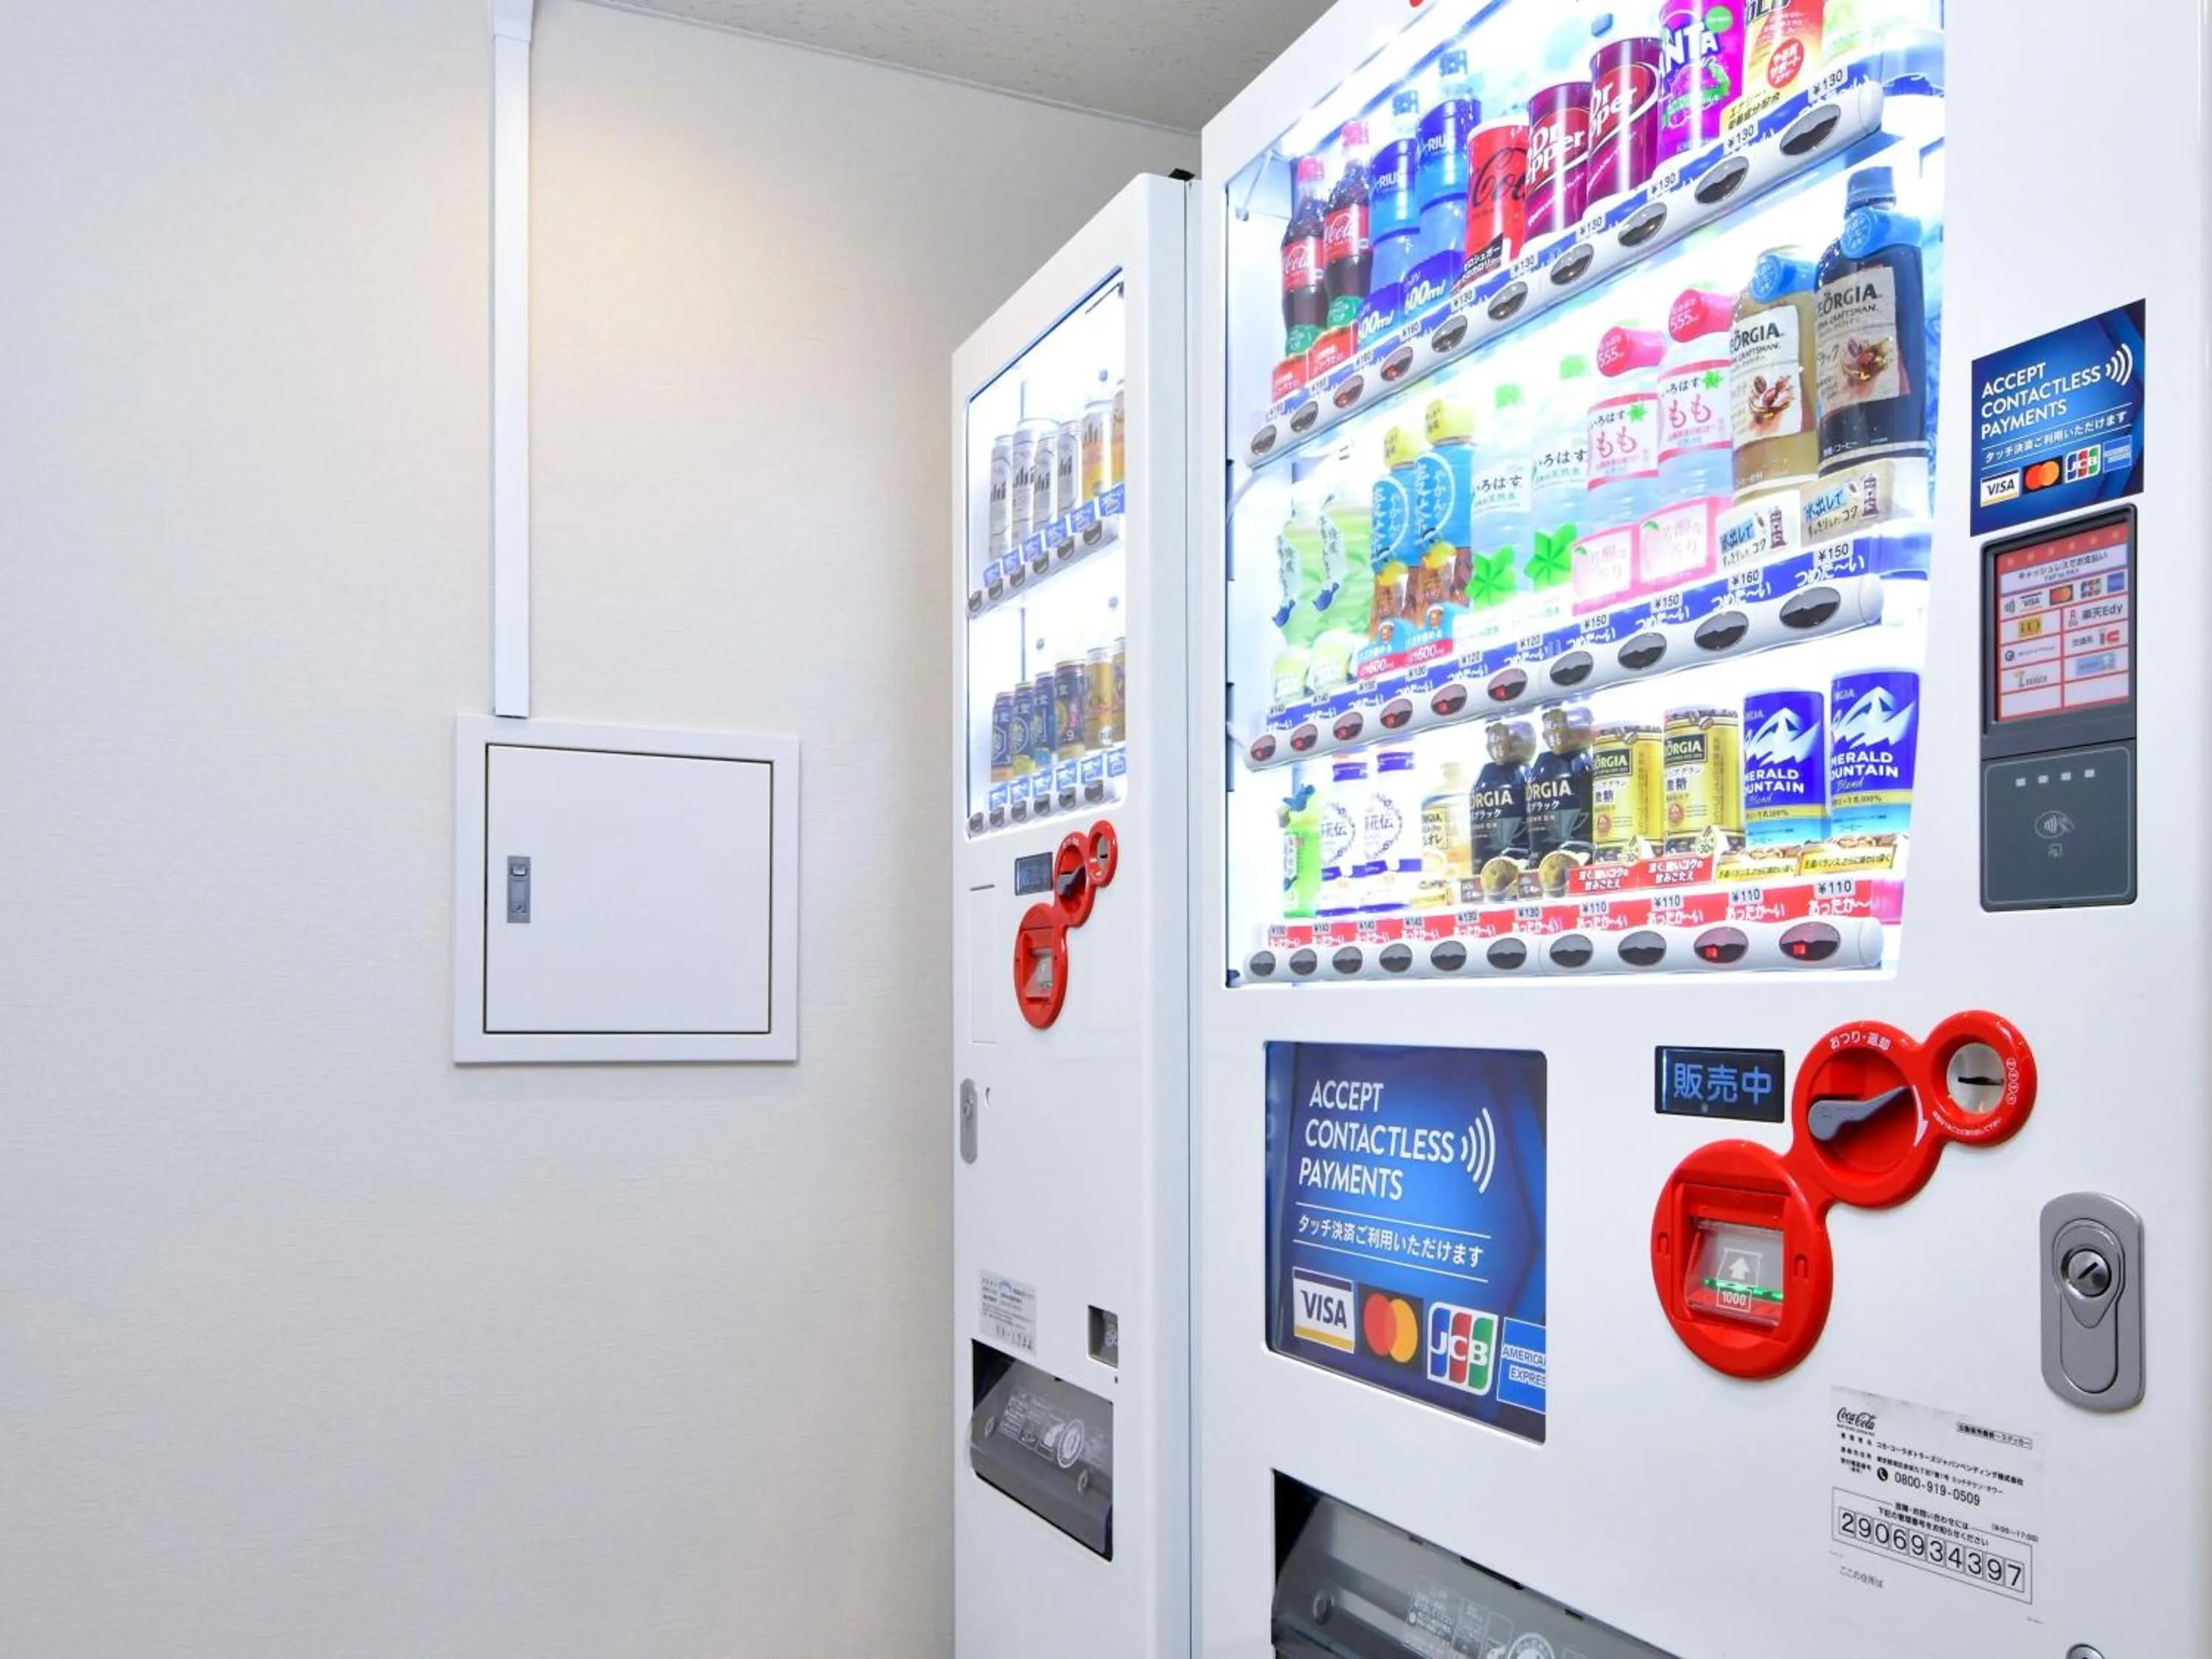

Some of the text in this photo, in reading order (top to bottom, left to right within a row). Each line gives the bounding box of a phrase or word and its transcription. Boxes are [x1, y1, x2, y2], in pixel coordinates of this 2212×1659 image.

[1813, 69, 1843, 95] ¥130
[1728, 125, 1754, 147] ¥130
[1982, 362, 2046, 399] ACCEPT
[1982, 366, 2101, 419] CONTACTLESS
[1982, 399, 2067, 440] PAYMENTS
[1986, 411, 2127, 463] タッチ決済ご利用いただけます
[1987, 479, 2015, 496] VISA
[1818, 543, 1849, 563] ¥150
[1733, 569, 1759, 586] ¥160
[1655, 594, 1680, 609] ¥150
[1520, 634, 1541, 648] ¥120
[1732, 888, 1761, 902] ¥110
[1818, 880, 1851, 895] ¥110
[1518, 907, 1540, 918] ¥130
[1582, 901, 1607, 914] ¥110
[1654, 894, 1681, 908] ¥110
[1673, 1062, 1773, 1105] 販売中
[1310, 1079, 1384, 1113] ACCEPT
[1305, 1118, 1455, 1164] CONTACTLESS
[1298, 1157, 1404, 1201] PAYMENTS
[1298, 1214, 1484, 1268] タッチ決済ご利用いただけます
[1301, 1290, 1348, 1329] VISA
[1722, 1292, 1747, 1306] 1000
[1503, 1347, 1546, 1367] AMERICA
[1894, 1471, 1980, 1506] 0800-919-0509
[1841, 1512, 2022, 1586] 2906934397
